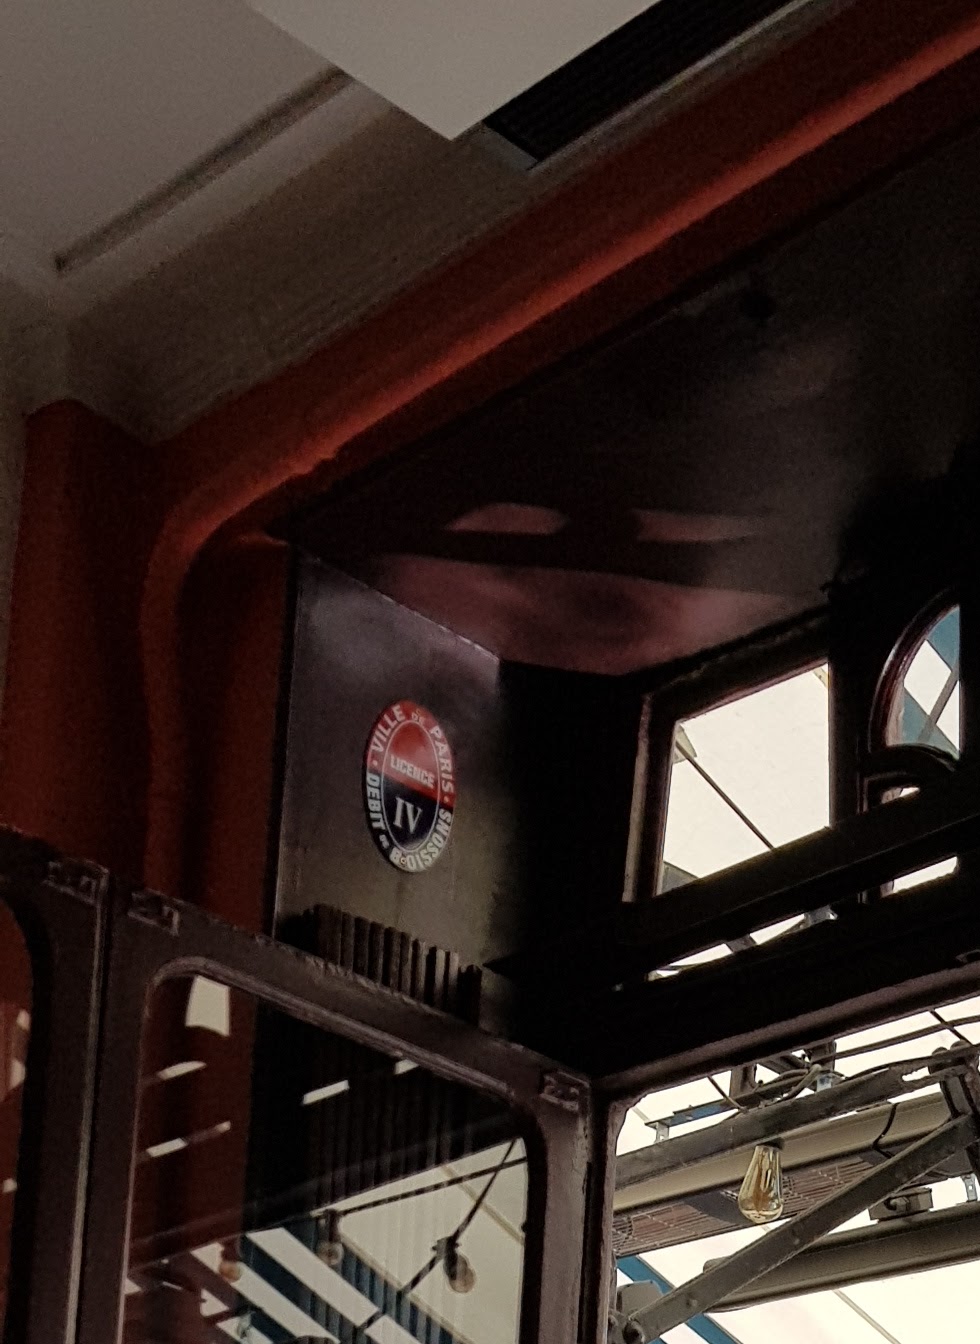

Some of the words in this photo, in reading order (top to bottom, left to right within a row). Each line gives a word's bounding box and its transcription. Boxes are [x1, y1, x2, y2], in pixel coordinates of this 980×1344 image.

[371, 704, 406, 753] VILLE
[429, 726, 454, 793] PARIS
[390, 756, 435, 790] LICENCE
[393, 797, 423, 835] IV
